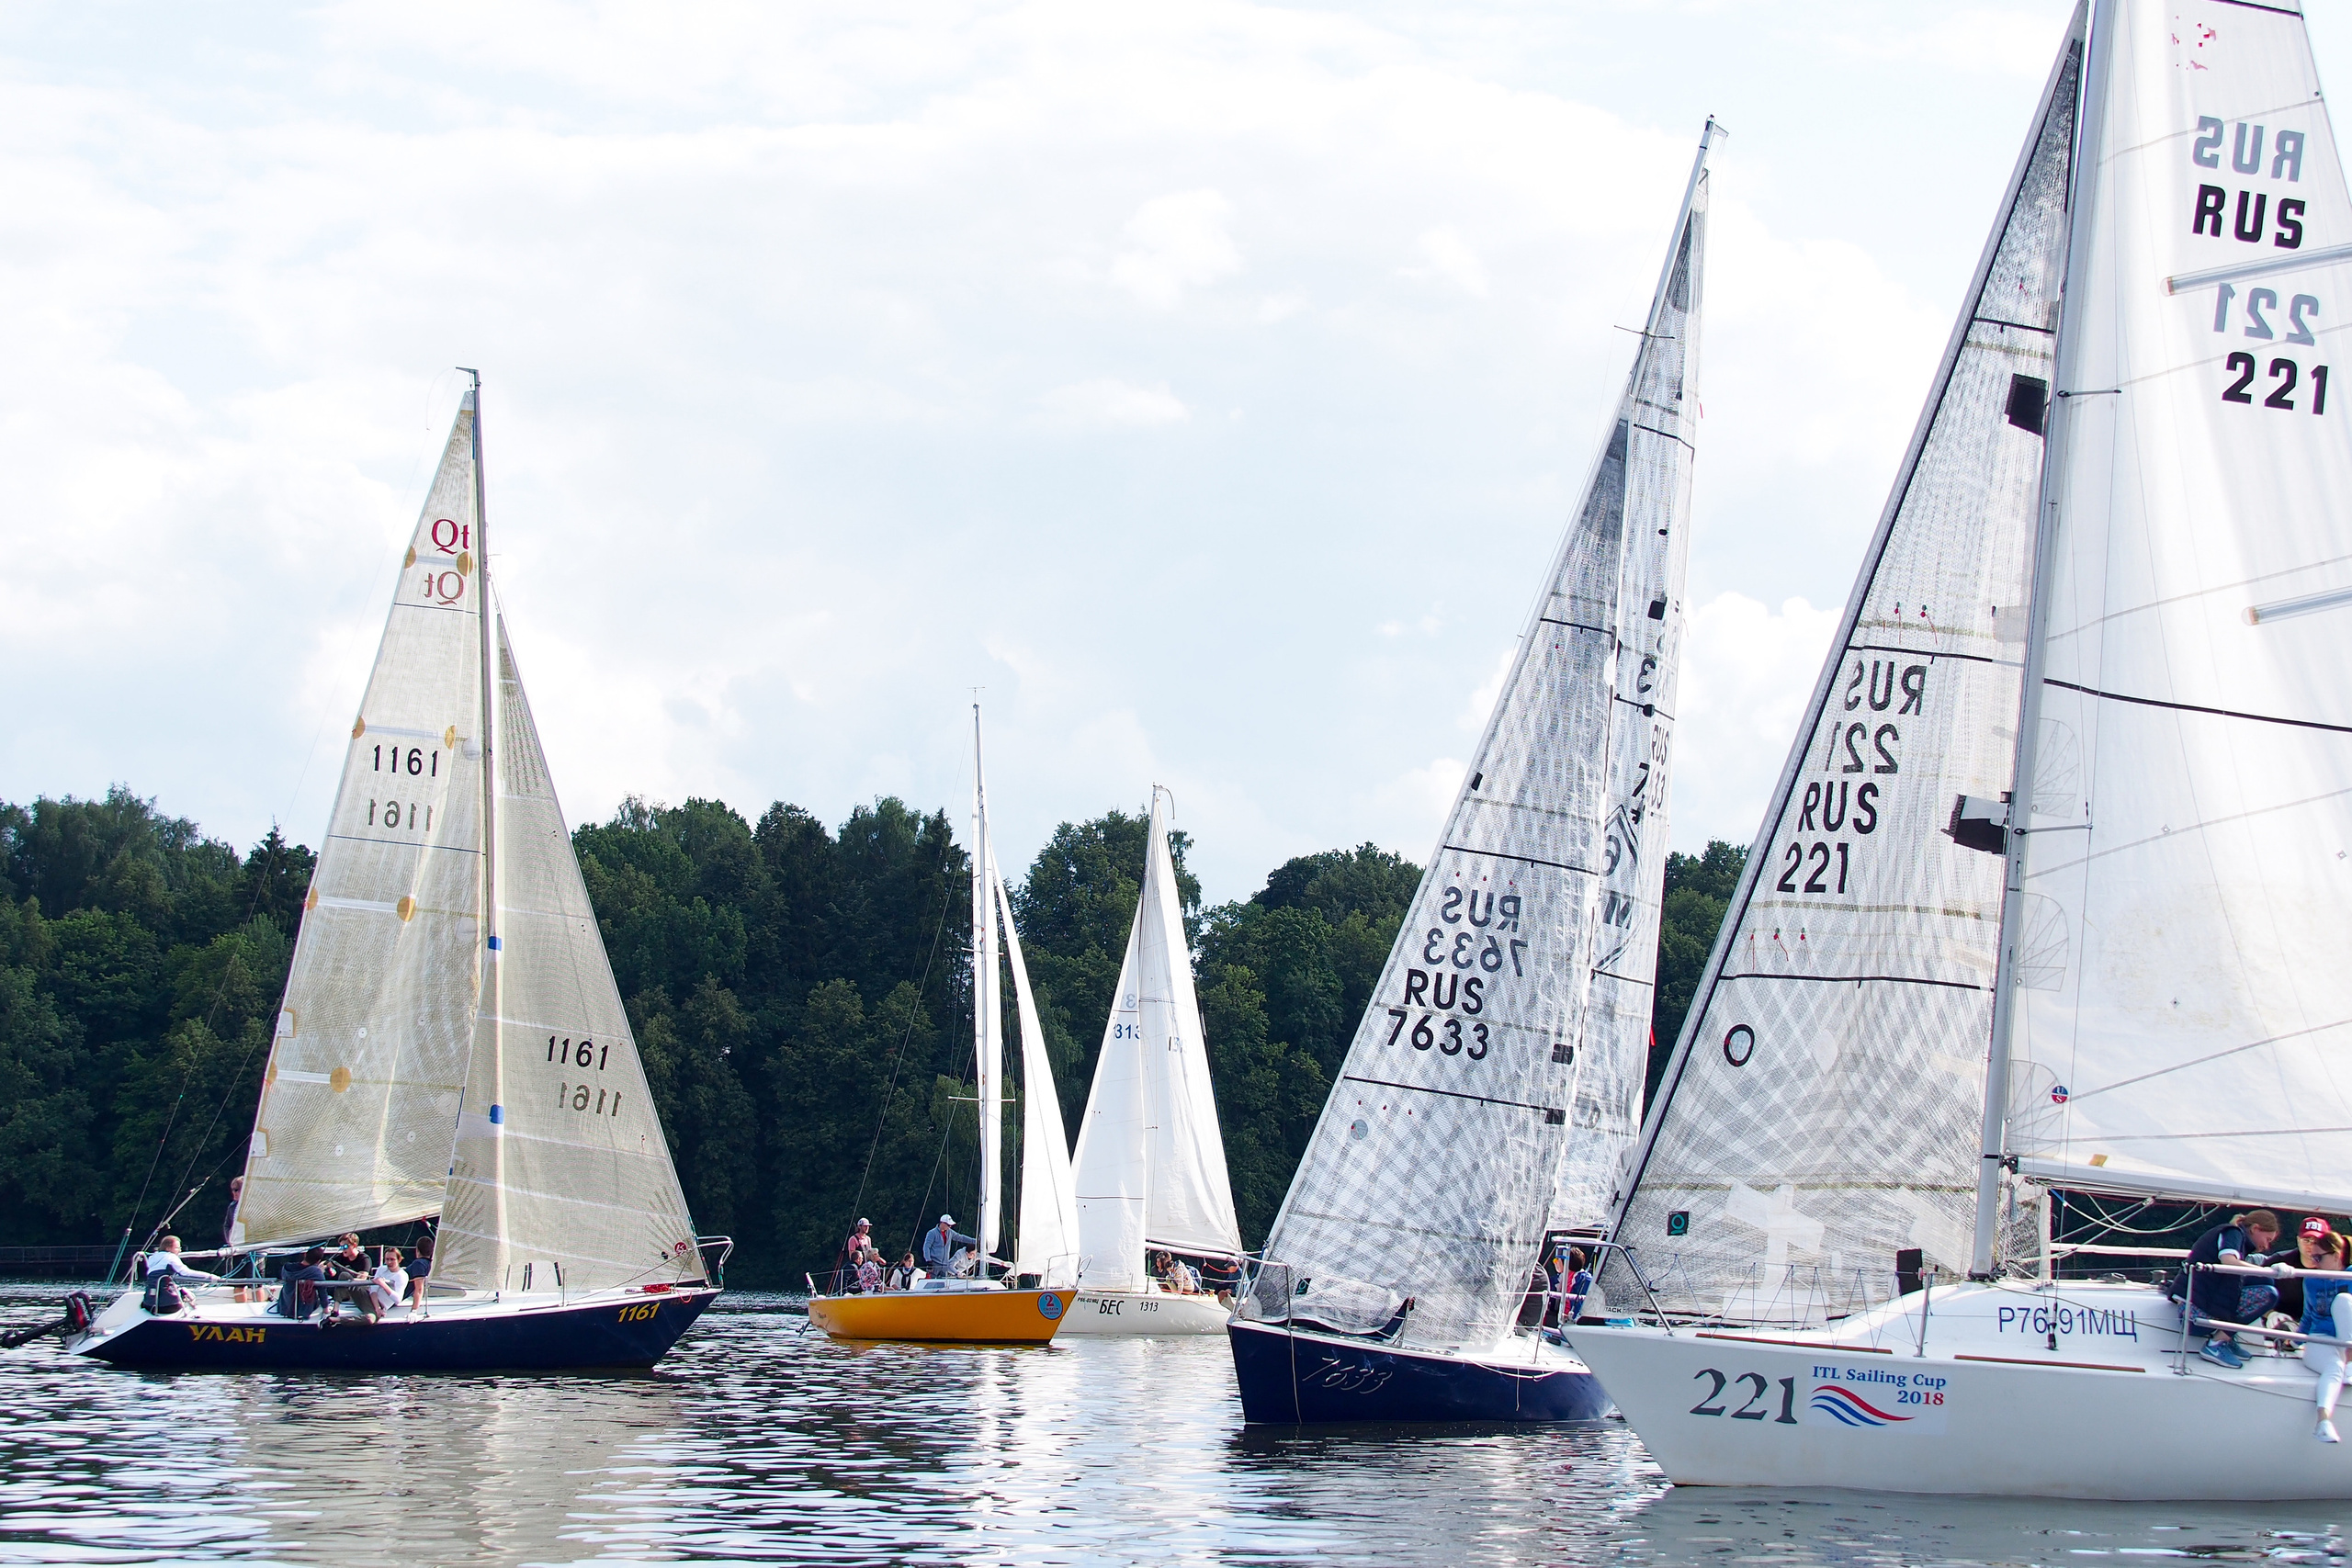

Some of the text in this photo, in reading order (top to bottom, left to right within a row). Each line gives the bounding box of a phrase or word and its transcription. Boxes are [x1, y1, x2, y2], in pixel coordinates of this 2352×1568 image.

[2192, 184, 2306, 250] RUS
[2222, 352, 2328, 415] 221
[431, 519, 469, 555] Qt
[374, 744, 438, 777] 1161
[1797, 781, 1879, 834] RUS
[1776, 841, 1849, 894] 221
[1404, 968, 1485, 1015] RUS
[548, 1035, 608, 1071] 1161
[1387, 1009, 1489, 1061] 7633
[617, 1303, 661, 1323] 1161
[1045, 1295, 1055, 1306] 2
[1099, 1299, 1125, 1315] БЕС
[1139, 1301, 1159, 1313] 1313
[188, 1325, 266, 1343] УЛАН
[1813, 1365, 1947, 1390] ITL Sailing Cup
[1689, 1368, 1797, 1425] 221
[1897, 1390, 1944, 1405] 2018
